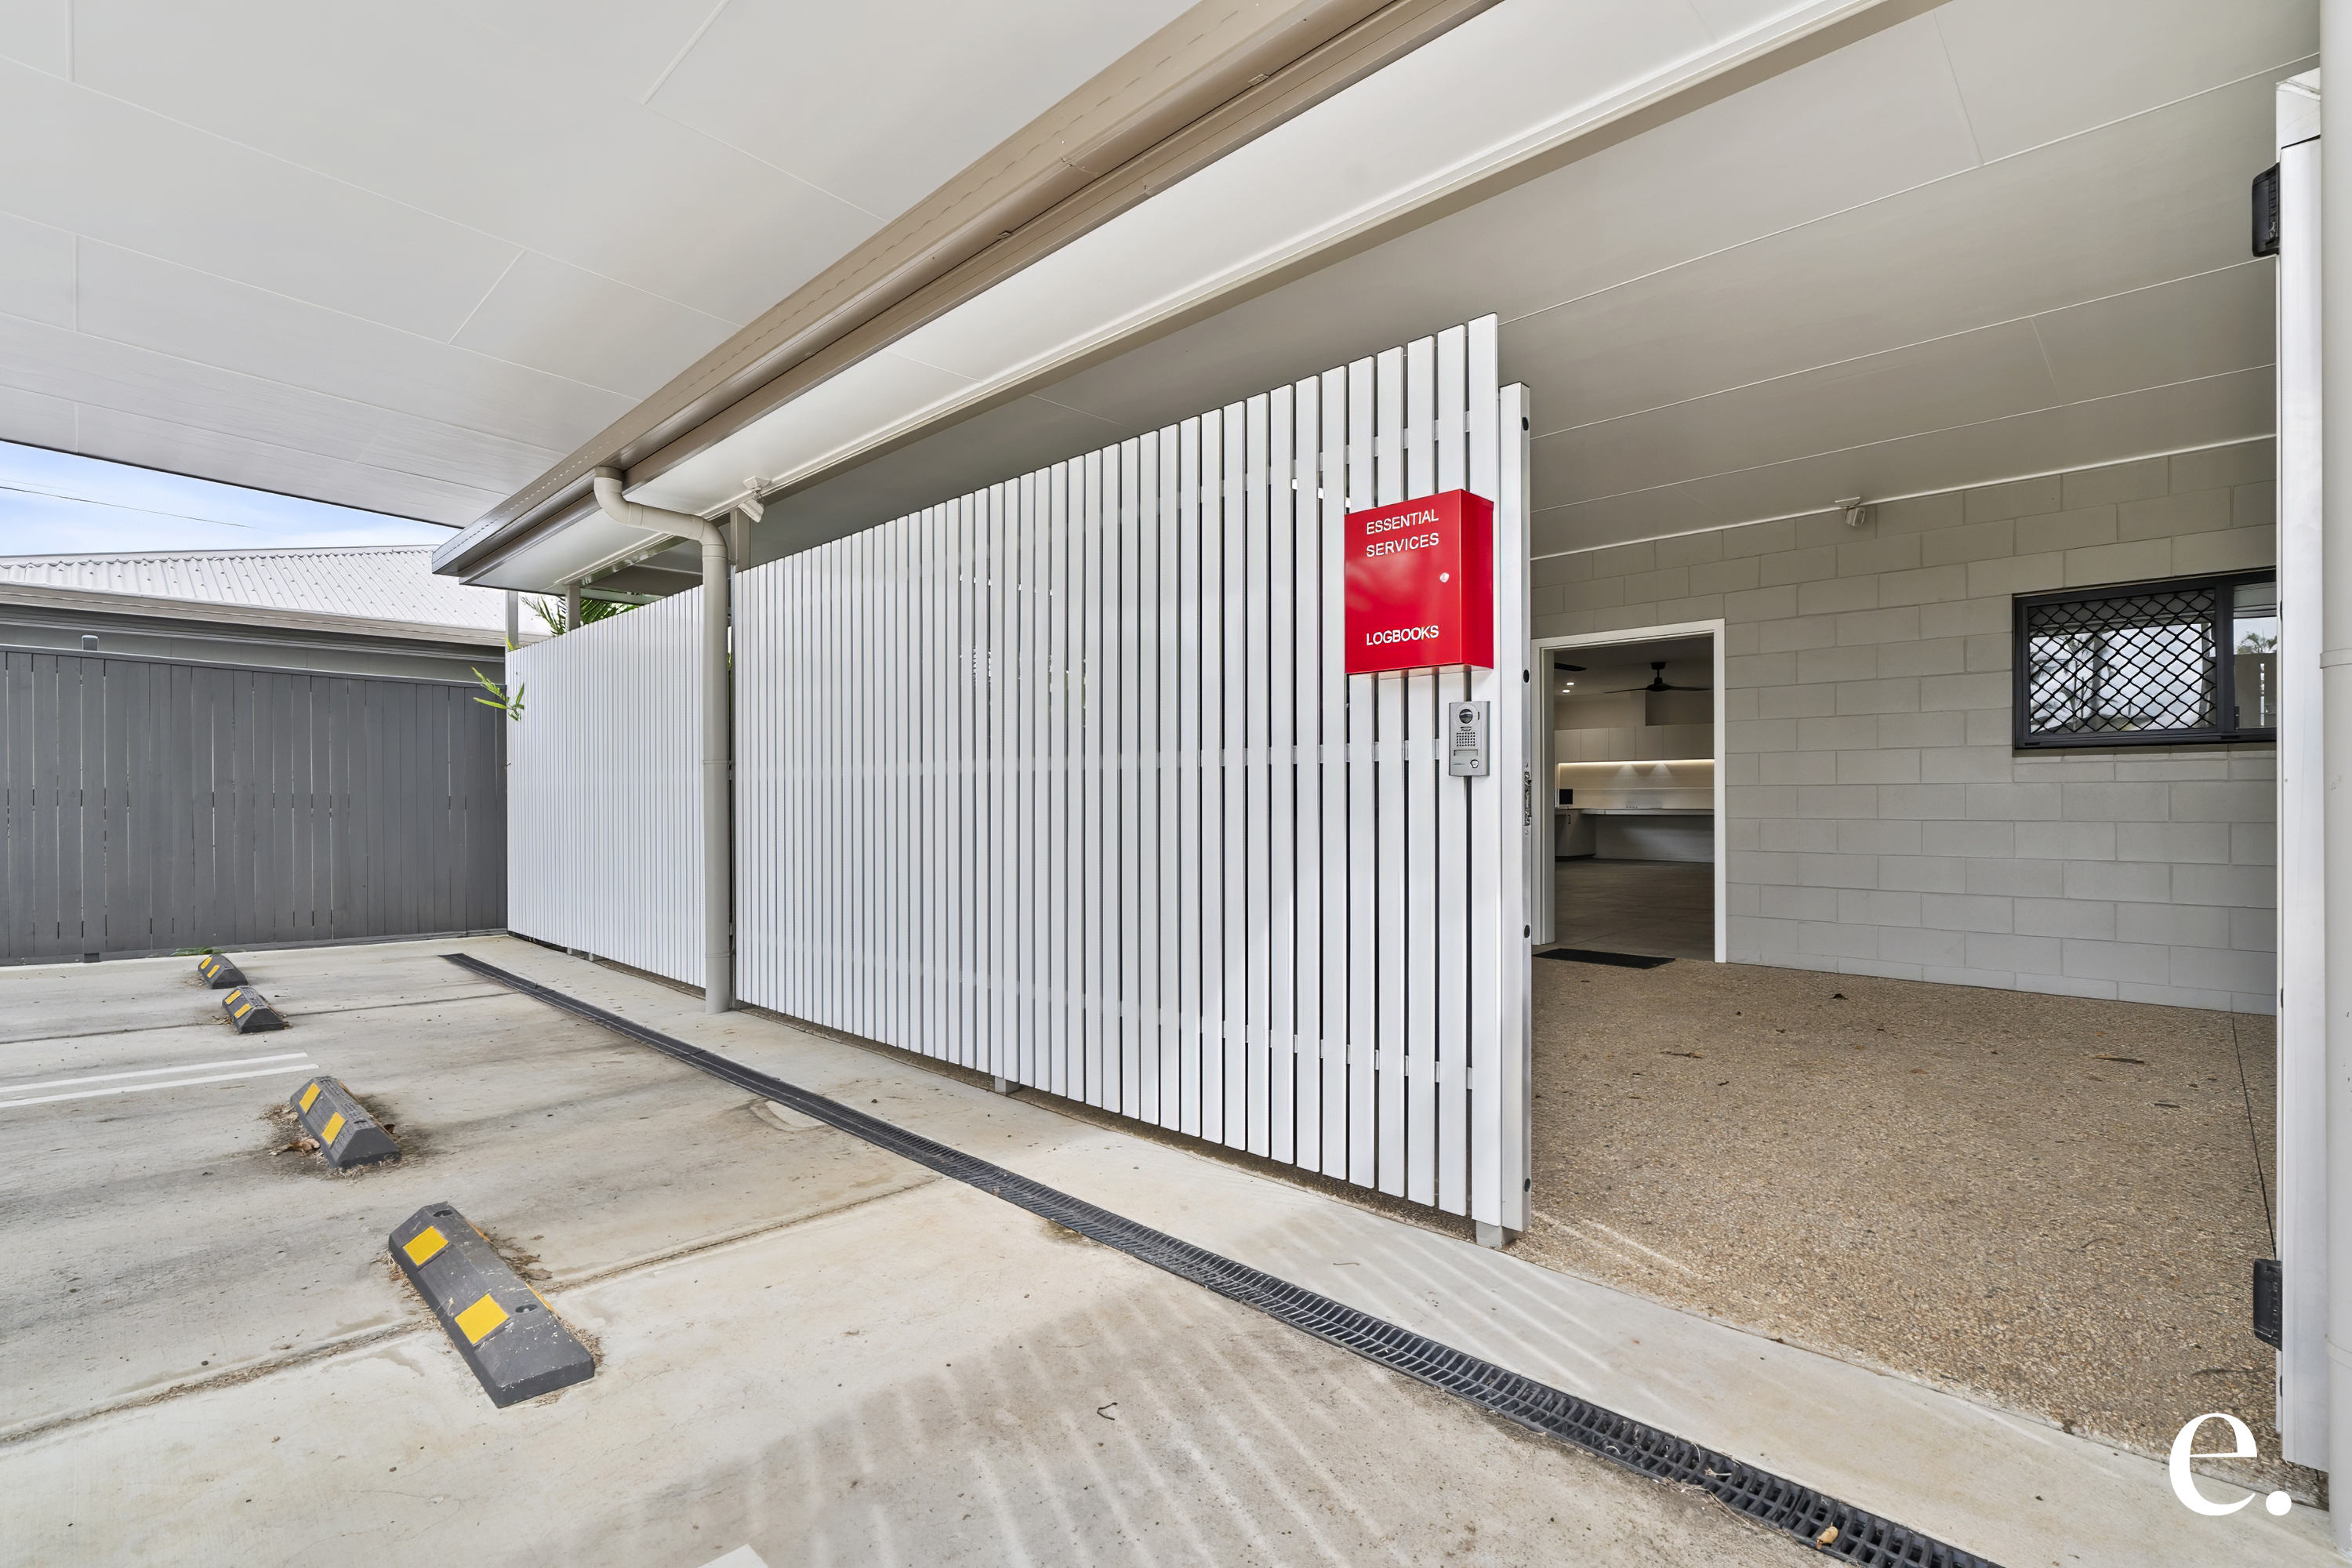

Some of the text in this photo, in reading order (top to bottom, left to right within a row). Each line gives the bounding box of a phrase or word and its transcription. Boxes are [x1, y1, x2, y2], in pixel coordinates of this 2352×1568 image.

[1366, 508, 1439, 535] ESSENTIAL
[1366, 532, 1439, 557] SERVICES
[1366, 625, 1439, 646] LOGBOOKS
